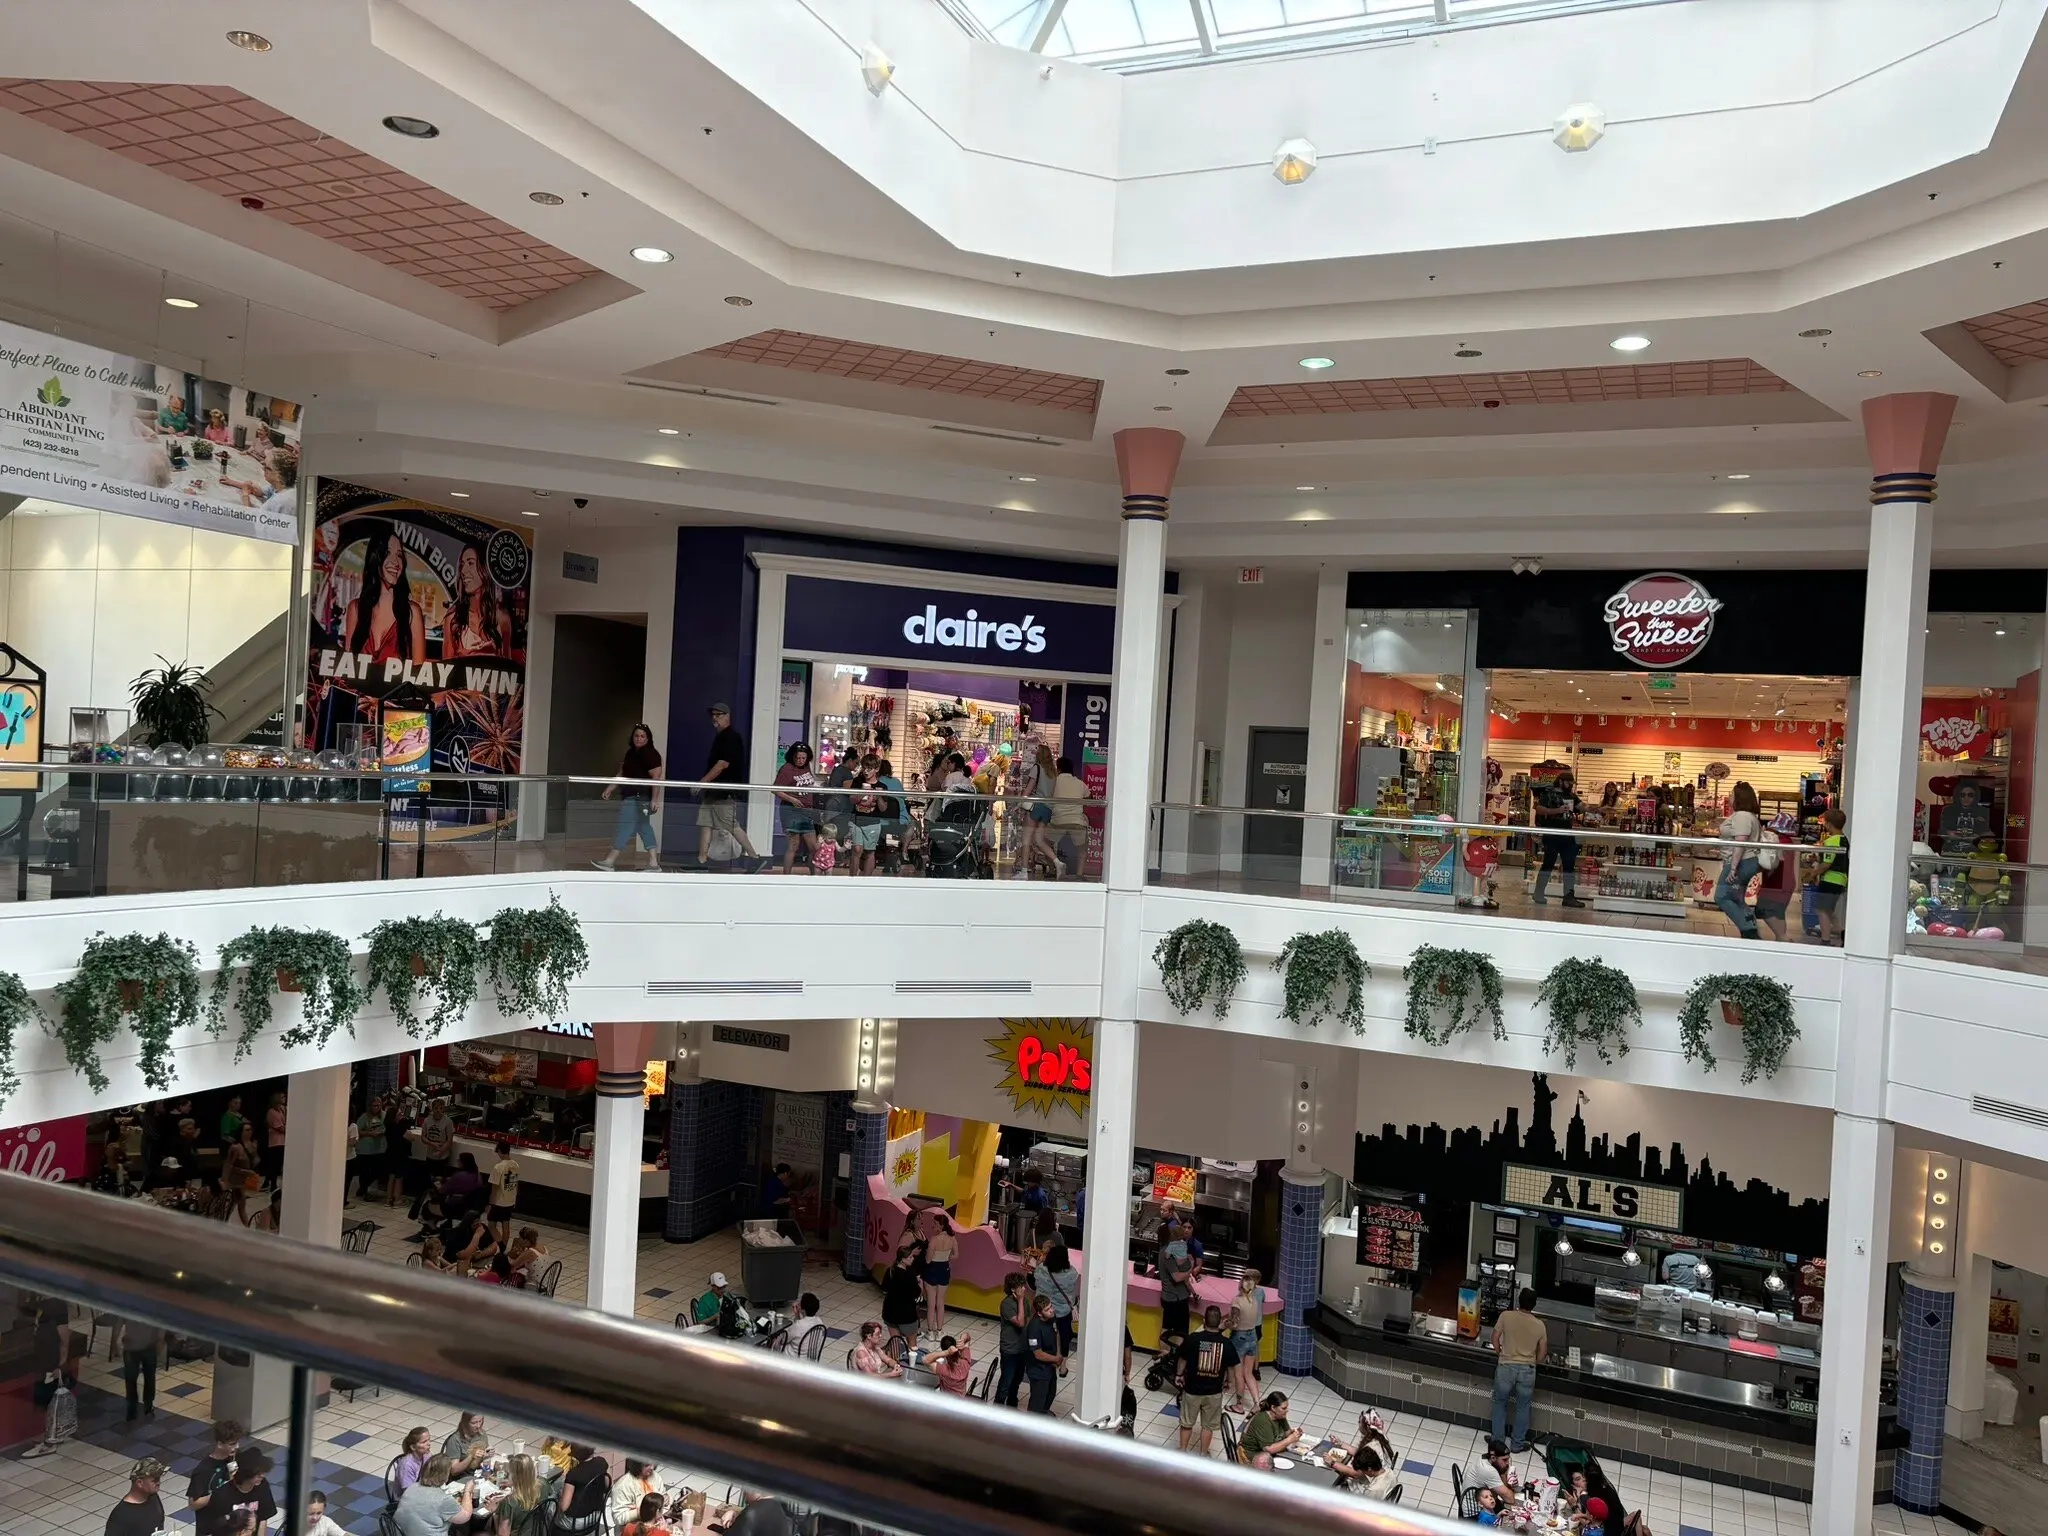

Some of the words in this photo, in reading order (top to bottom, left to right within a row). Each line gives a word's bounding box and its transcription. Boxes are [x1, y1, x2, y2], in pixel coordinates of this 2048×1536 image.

[0, 344, 41, 369] erfect
[42, 355, 81, 376] Place
[84, 365, 97, 379] to
[99, 367, 129, 387] Call
[130, 375, 172, 396] Home!
[0, 407, 63, 431] CHRISTIAN
[66, 423, 105, 441] LIVING
[18, 401, 88, 426] ABUNDANT
[28, 427, 75, 443] COMMUNITY
[22, 438, 43, 451] (423)
[44, 442, 80, 457] 232-8218
[53, 472, 88, 491] Living
[100, 482, 147, 501] Assisted
[150, 491, 181, 510] Living
[192, 500, 257, 522] Rehabilitation
[259, 514, 291, 529] Center
[393, 519, 430, 556] WIN
[490, 533, 526, 569] TIEBREAKERS
[1242, 568, 1261, 582] EXIT
[1603, 588, 1725, 623] Sweeter
[903, 604, 1047, 653] claire's
[1646, 617, 1675, 629] than
[1612, 616, 1711, 652] Sweet
[319, 648, 373, 680] EAT
[383, 656, 455, 689] PLAY
[464, 665, 519, 696] WIN
[1922, 716, 1981, 744] TAFFY
[1931, 738, 1962, 751] TOWN
[1087, 774, 1107, 783] New
[390, 820, 438, 832] THEARE
[1428, 869, 1451, 878] SOLD
[1428, 876, 1449, 885] HERE
[720, 1028, 781, 1048] ELEVATOR
[1018, 1035, 1092, 1090] Pal's
[1024, 1081, 1055, 1091] SUDDEN
[1541, 1175, 1639, 1218] AL'S
[1361, 1216, 1368, 1225] 2
[1368, 1217, 1390, 1227] SLICES
[1391, 1220, 1403, 1229] AND
[1409, 1222, 1430, 1233] DRINK
[1364, 1204, 1425, 1225] PIZZA
[1790, 1400, 1814, 1413] ORDER
